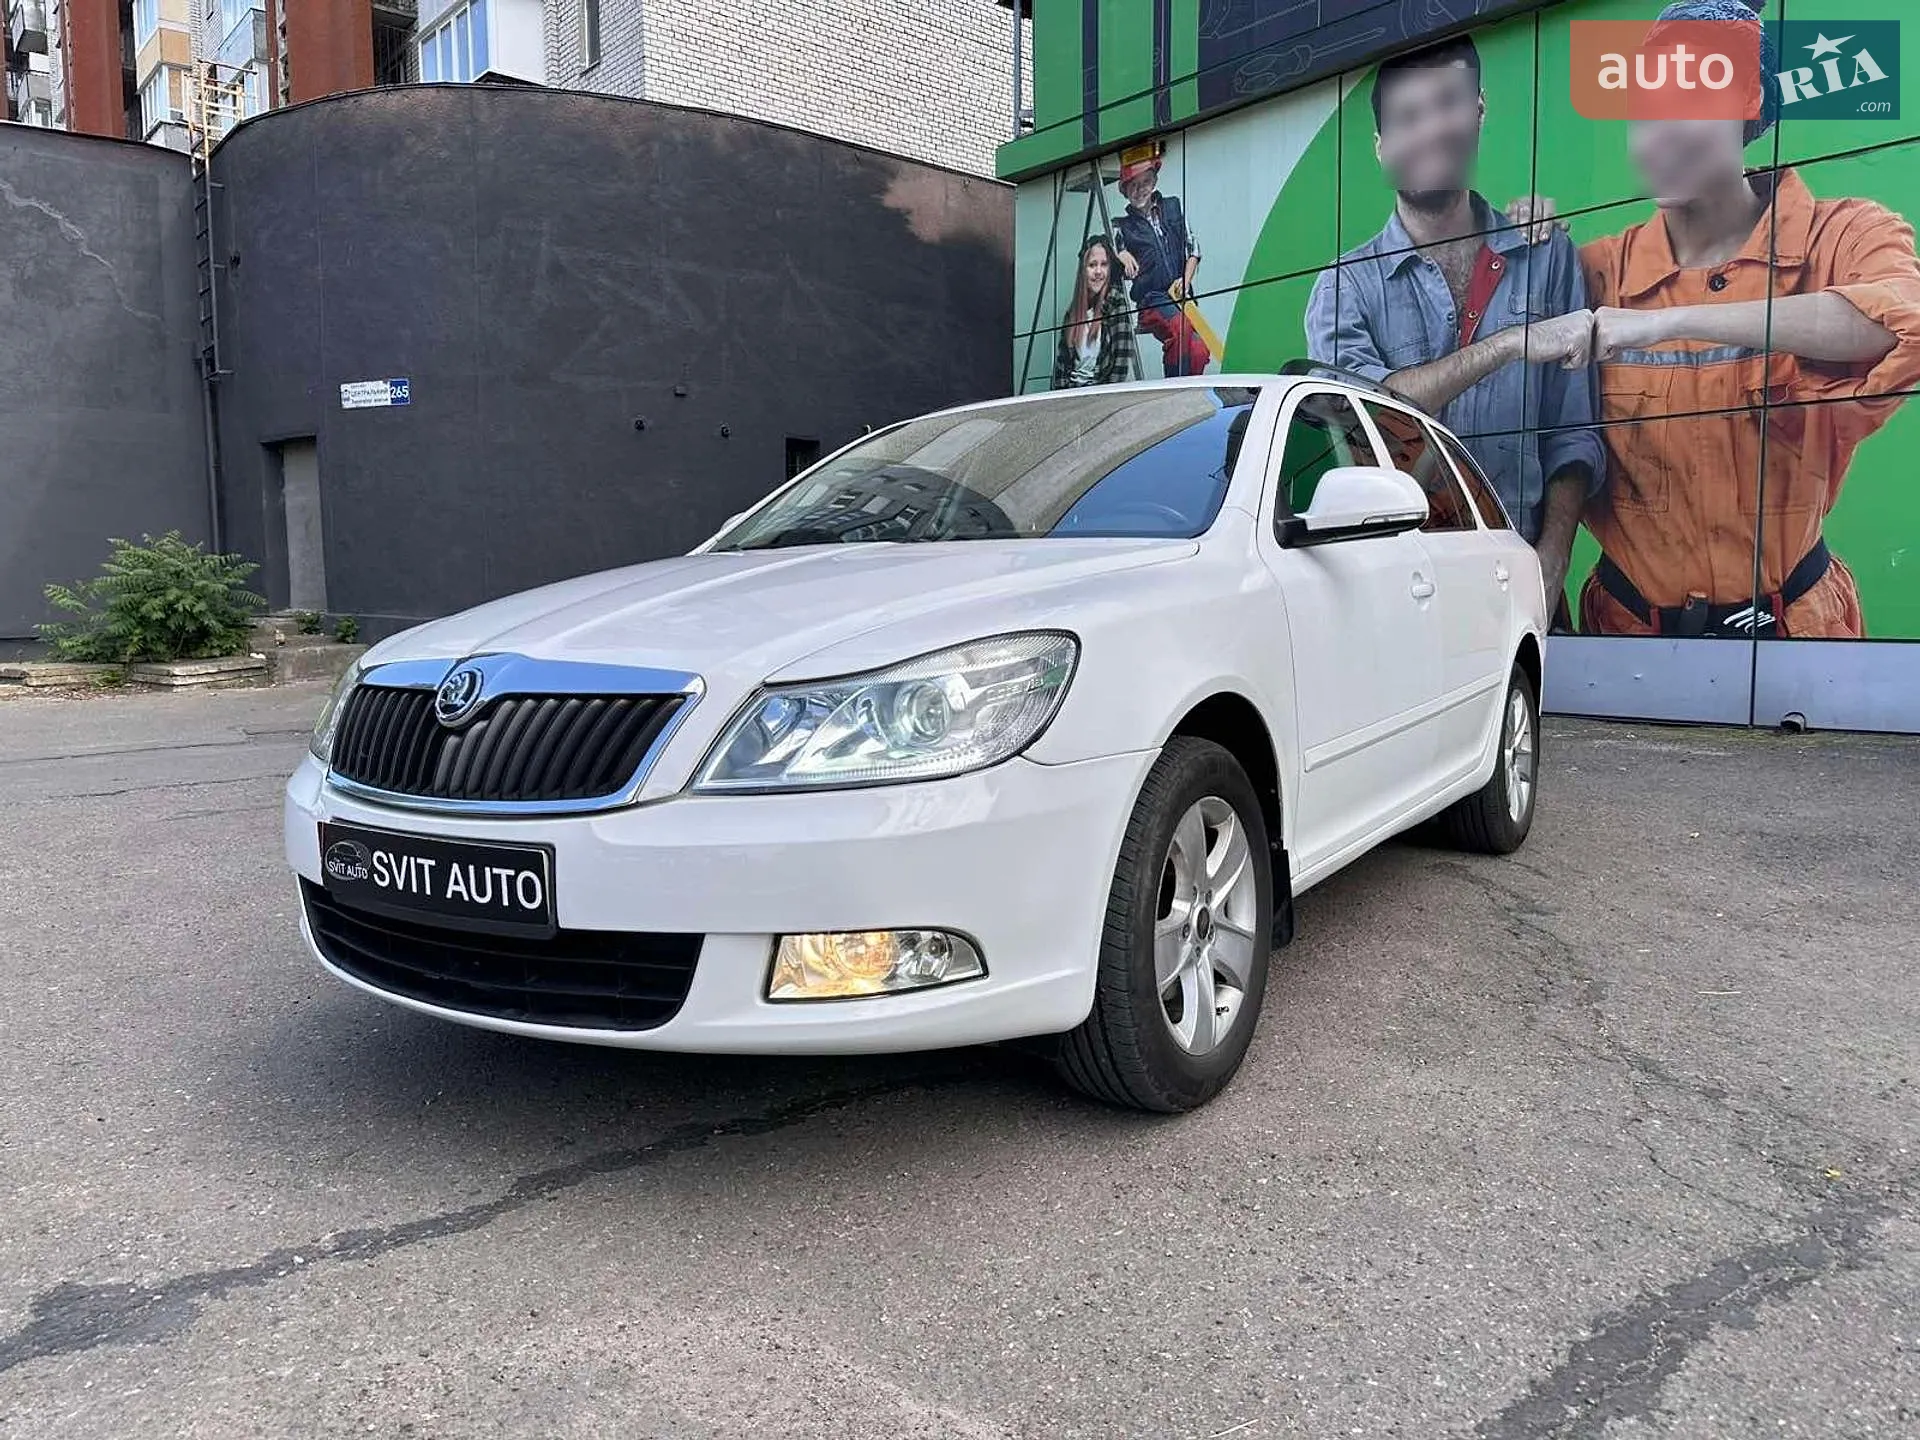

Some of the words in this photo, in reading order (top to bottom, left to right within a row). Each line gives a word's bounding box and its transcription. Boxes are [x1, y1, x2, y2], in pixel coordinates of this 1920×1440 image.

[390, 385, 409, 399] 265
[328, 860, 345, 874] SVIT
[346, 865, 368, 880] AUTO
[371, 850, 436, 896] SVIT
[445, 862, 543, 910] AUTO
